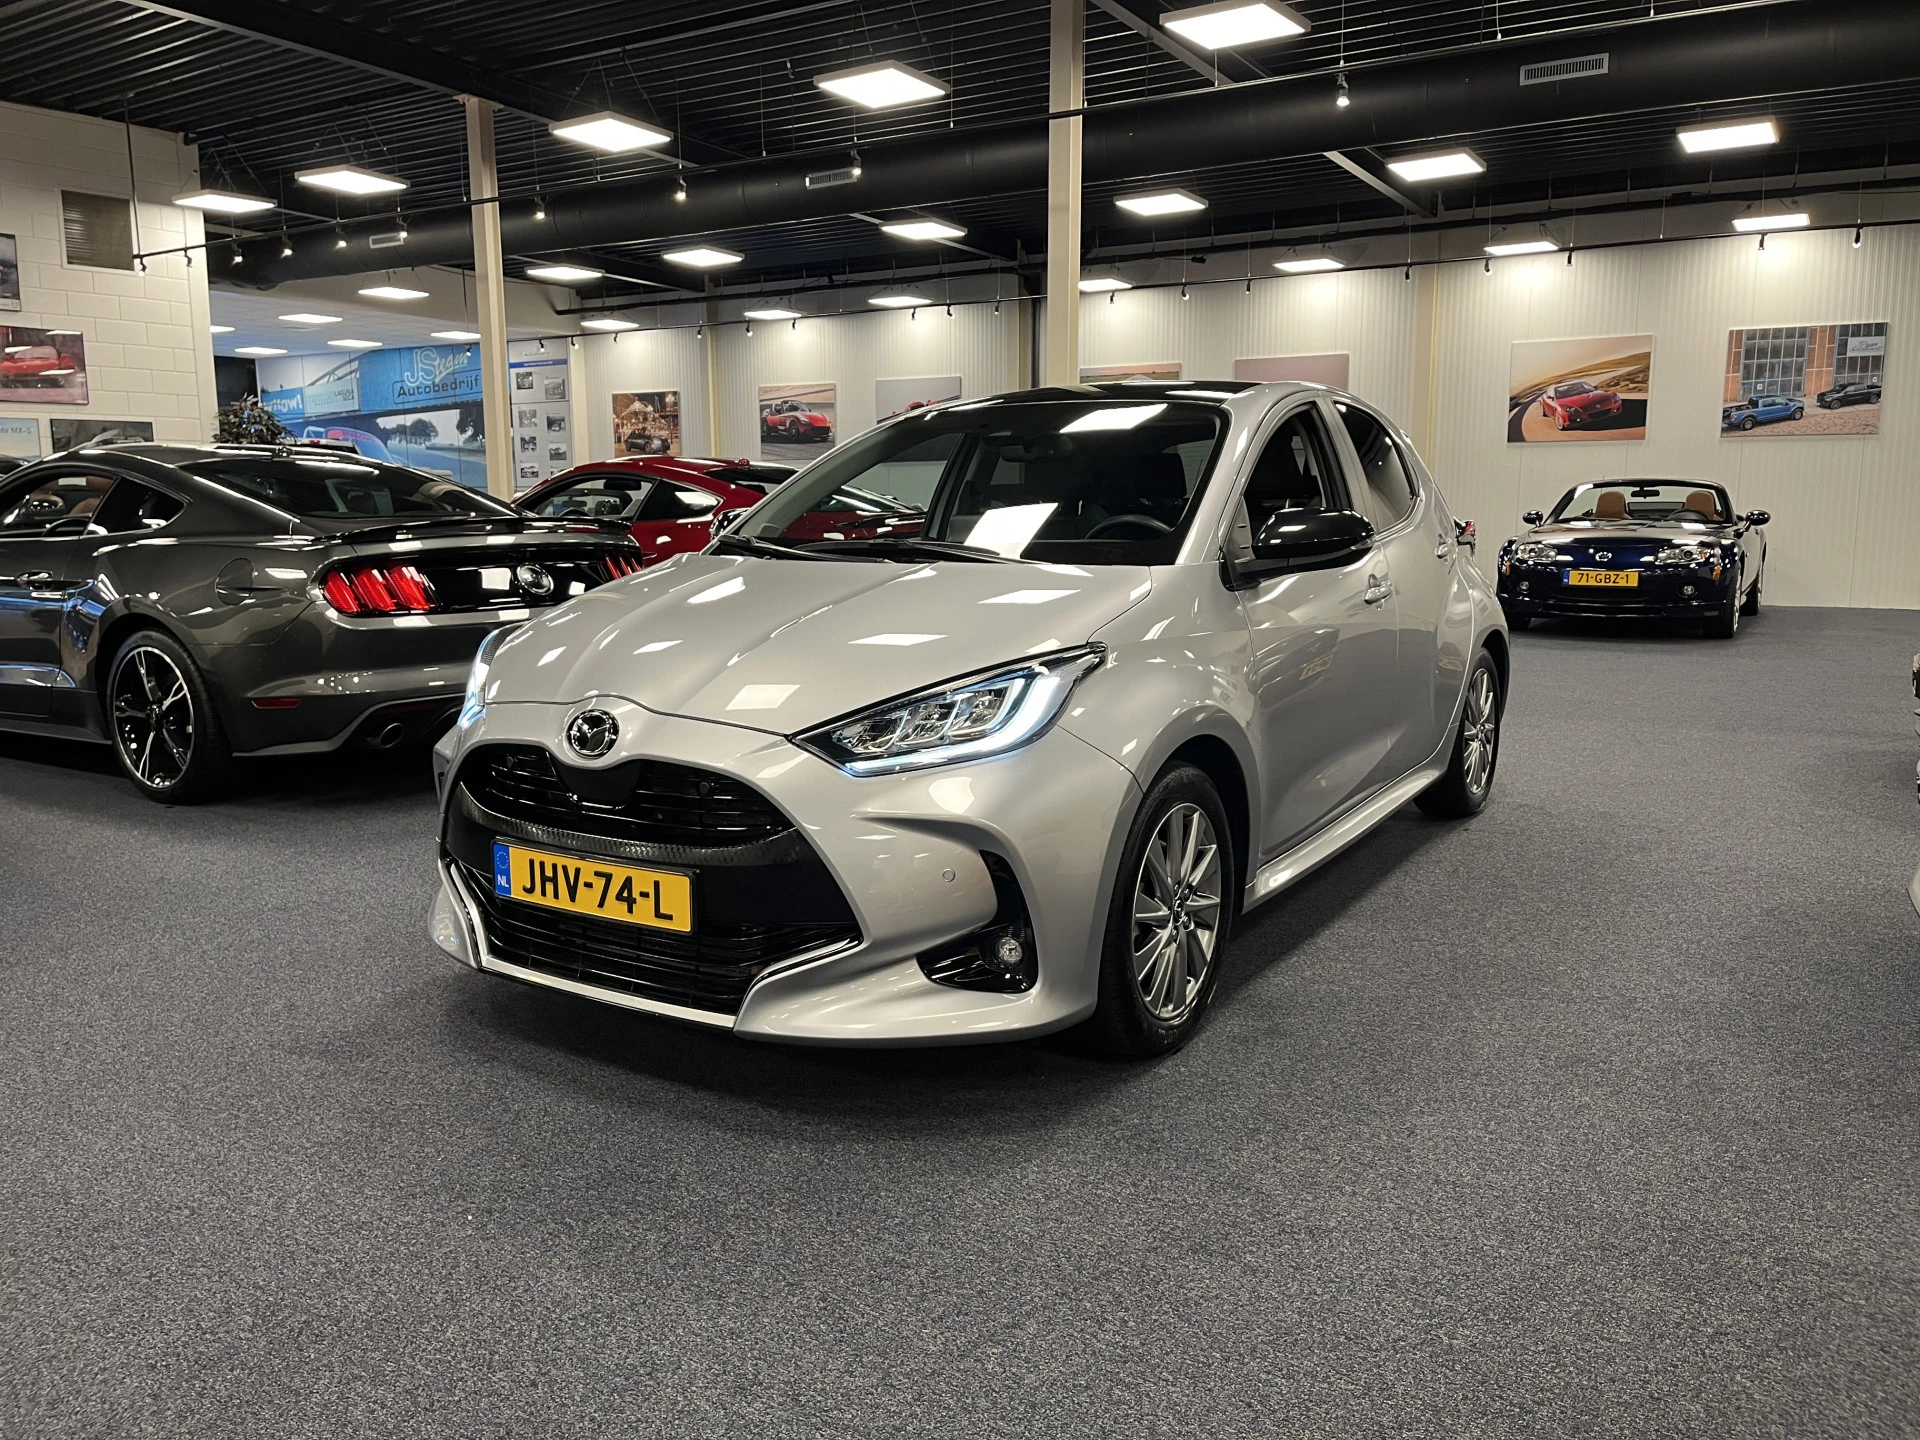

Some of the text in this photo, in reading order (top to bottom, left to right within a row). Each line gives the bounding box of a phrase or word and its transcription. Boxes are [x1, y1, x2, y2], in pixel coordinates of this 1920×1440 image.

[397, 375, 480, 398] Autobedrijf
[1577, 573, 1629, 584] 71-GBZ-1
[497, 874, 509, 887] NL
[522, 858, 674, 921] JHV-74-L
